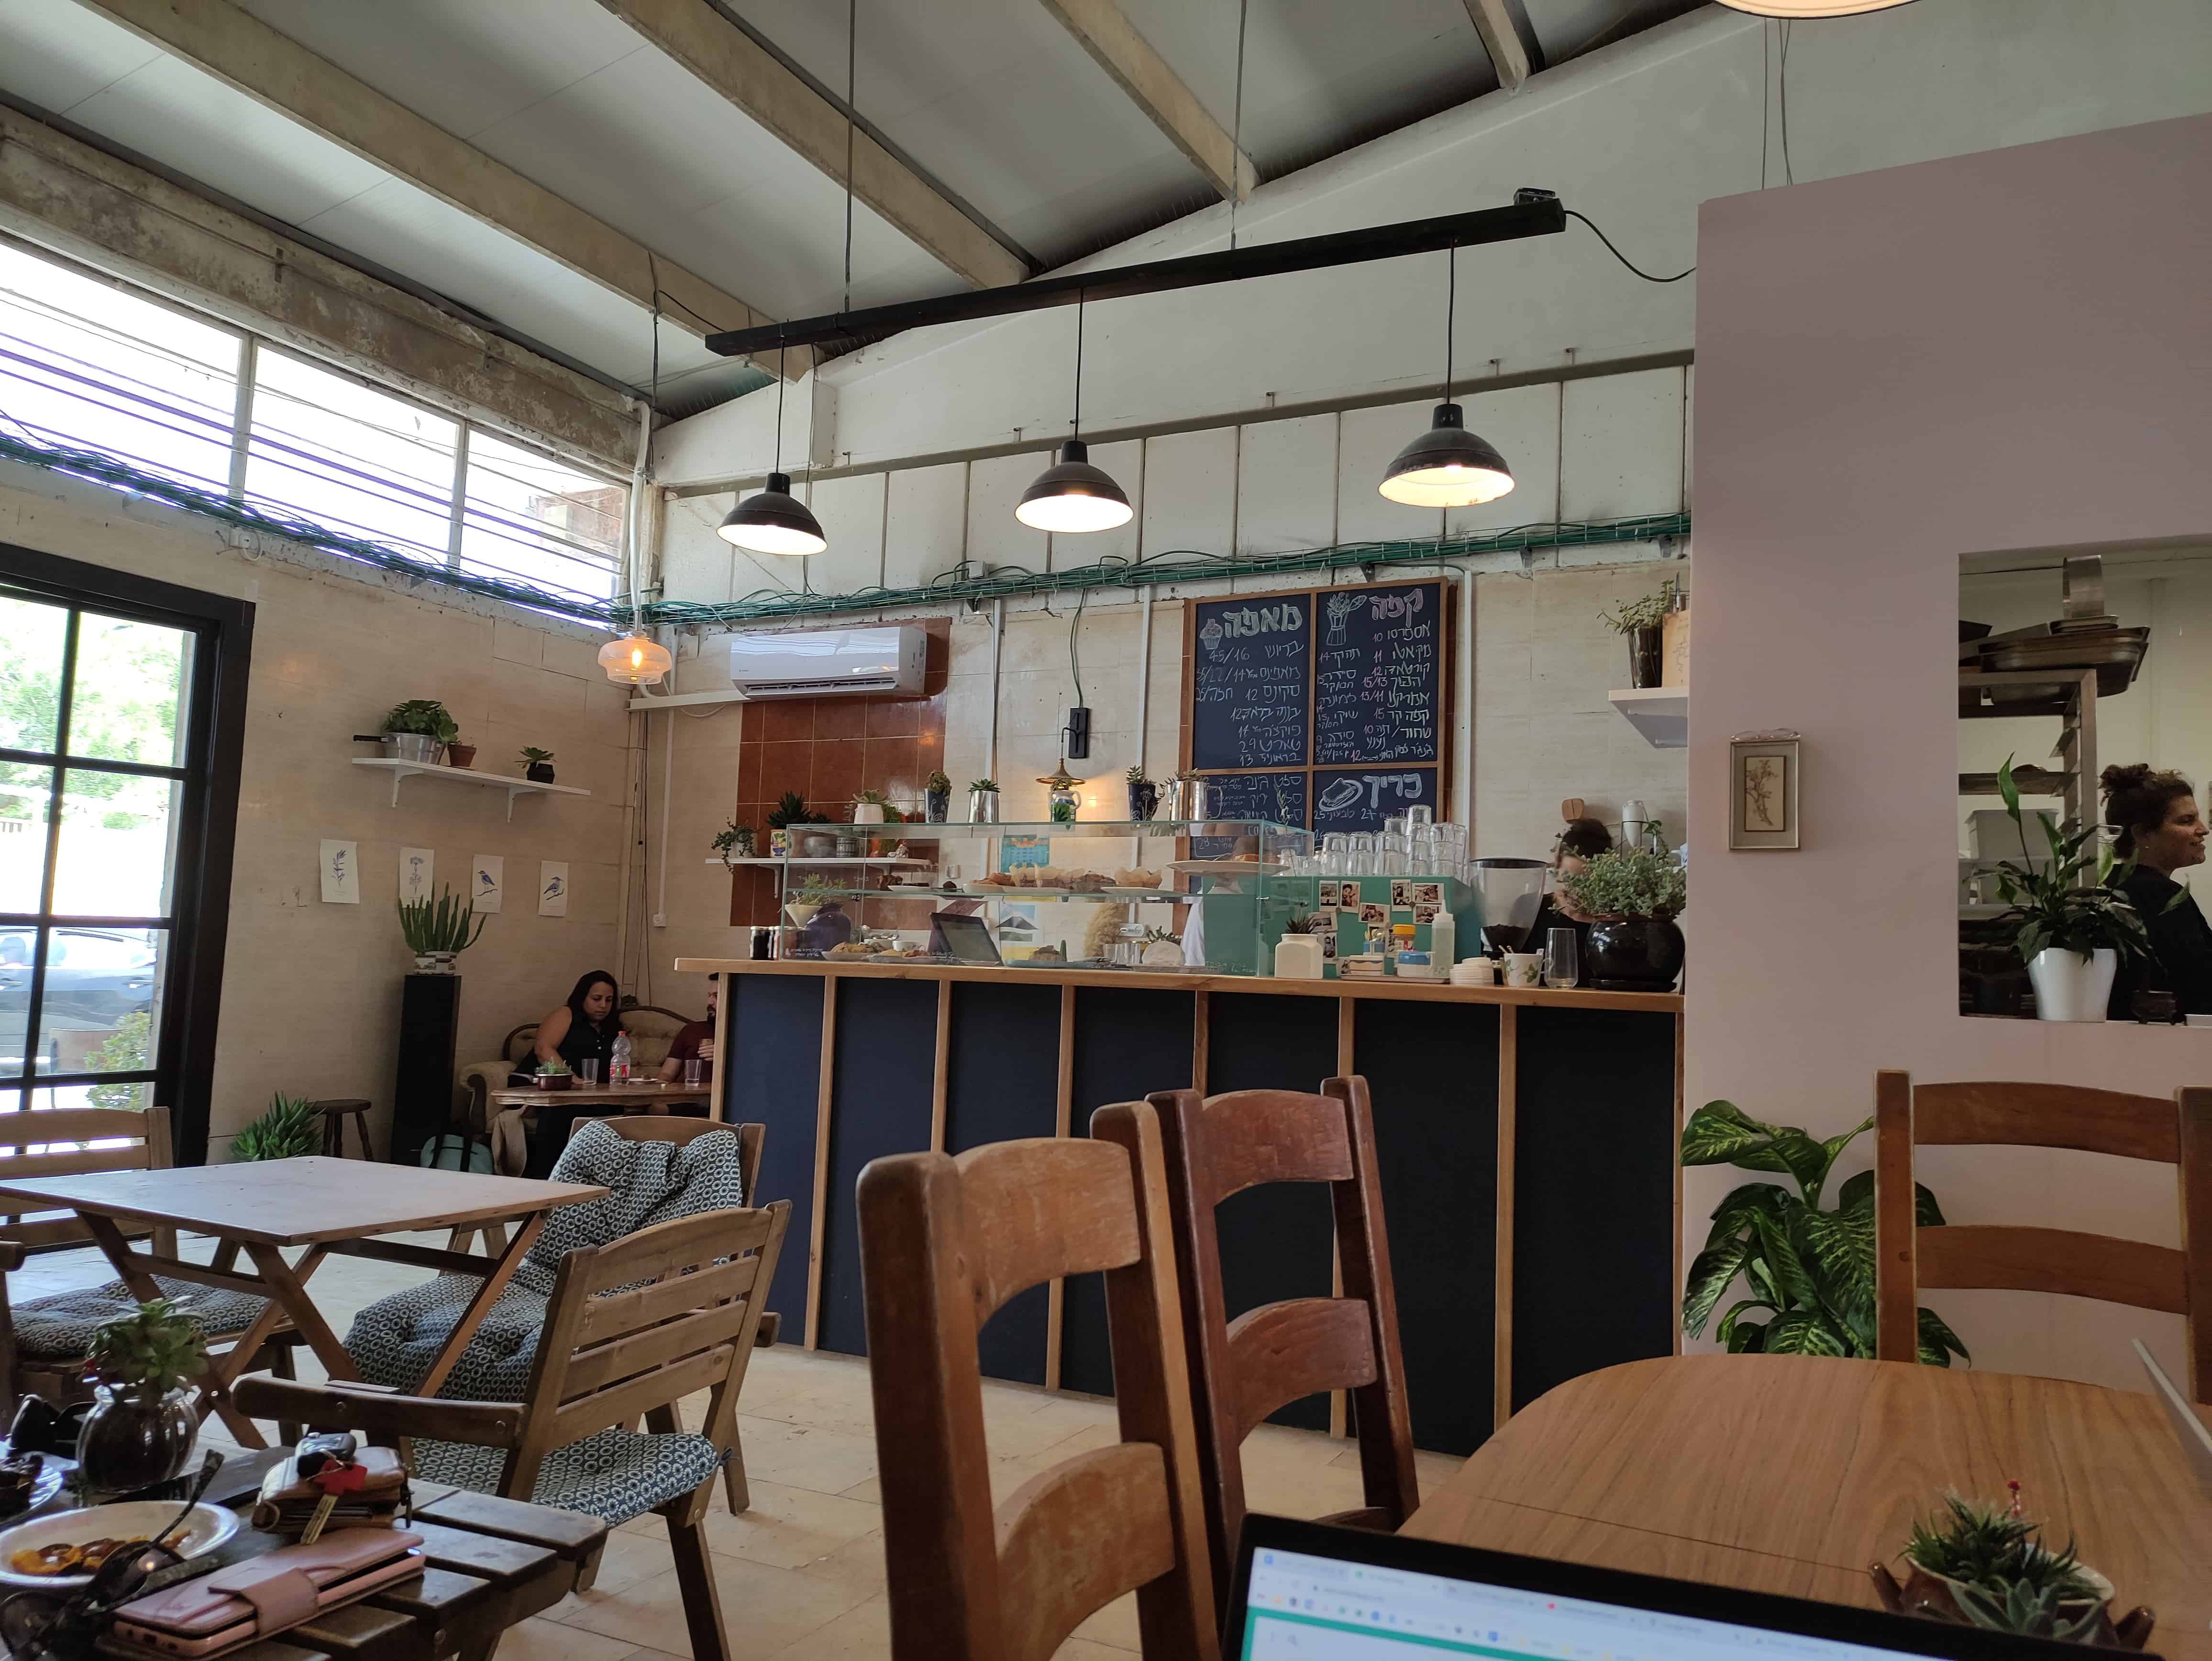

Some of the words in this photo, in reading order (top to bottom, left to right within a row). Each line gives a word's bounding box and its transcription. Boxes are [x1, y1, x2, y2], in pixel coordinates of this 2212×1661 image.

[1369, 588, 1424, 628] קפה
[1222, 603, 1303, 638] מאפה
[1388, 620, 1430, 641] אספרסו
[1373, 632, 1383, 643] 10
[1264, 640, 1304, 658] בריוש
[1319, 652, 1330, 663] 14
[1373, 650, 1382, 663] 11
[1371, 666, 1382, 677] 12
[1362, 676, 1387, 688] 15/13
[1245, 688, 1258, 701] 12
[1360, 690, 1384, 702] 13/11
[1230, 707, 1242, 722] 12
[1374, 708, 1385, 720] 15
[1405, 709, 1429, 726] קפה
[1239, 724, 1250, 738] 14
[1363, 725, 1373, 735] 10
[1239, 738, 1256, 752] 29
[1260, 738, 1301, 752] טארט
[1240, 753, 1253, 766] 13
[1350, 750, 1361, 763] 12
[1362, 773, 1422, 808] כריך
[1314, 810, 1325, 819] 25
[1361, 808, 1377, 820] 27
[1196, 838, 1210, 850] 28
